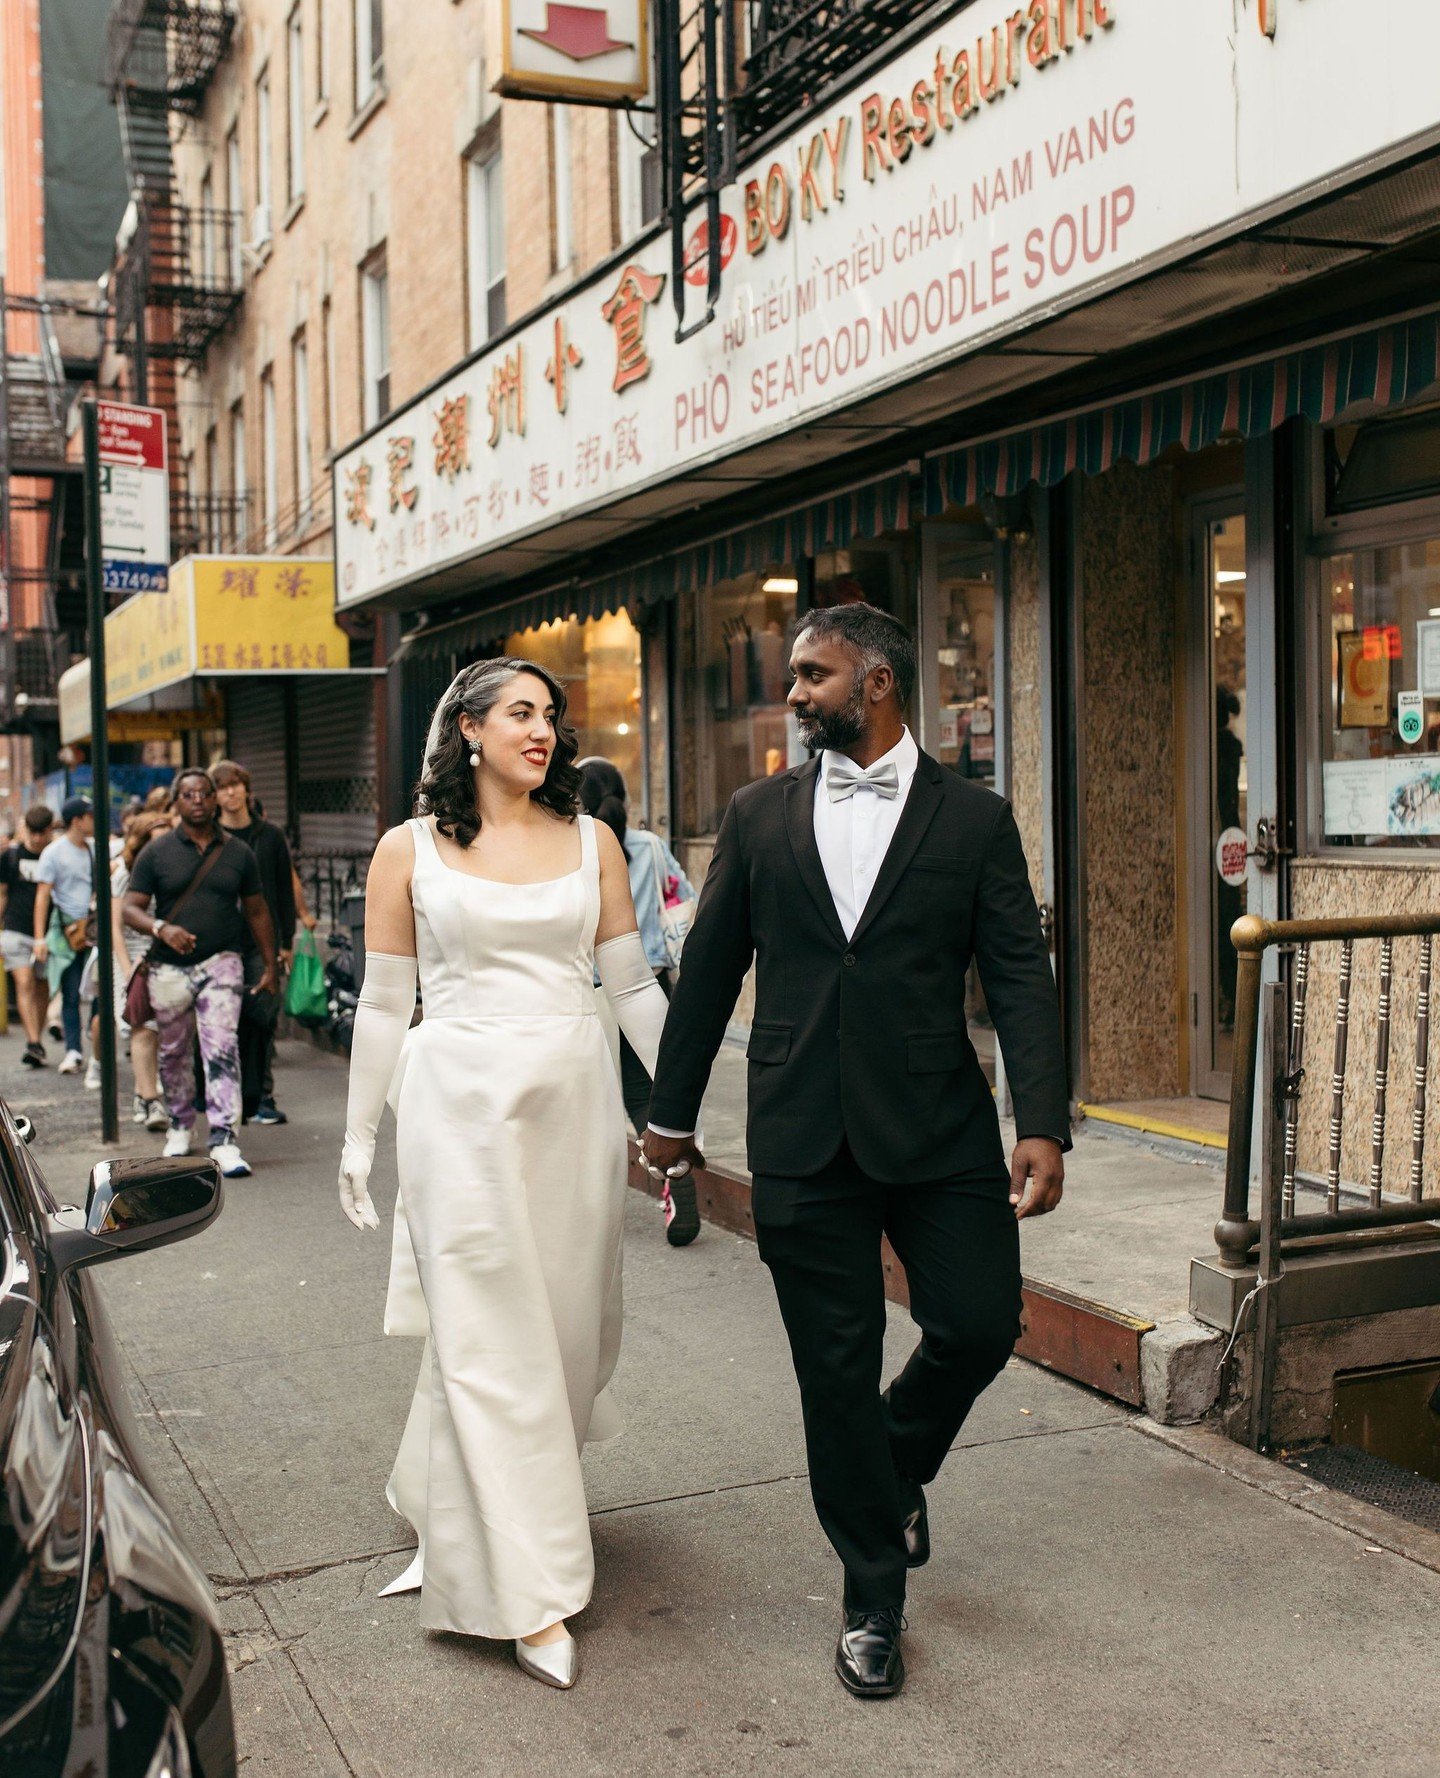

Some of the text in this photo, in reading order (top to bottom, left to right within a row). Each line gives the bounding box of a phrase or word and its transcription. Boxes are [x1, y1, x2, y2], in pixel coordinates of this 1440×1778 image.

[744, 163, 790, 256] BO
[798, 116, 850, 221] KY
[892, 184, 964, 263] CHÂU,
[972, 150, 1033, 221] NAM
[1043, 97, 1136, 178] VANG
[750, 315, 870, 415] SEAFOOD
[881, 243, 1011, 358] NOODLE
[1023, 185, 1135, 289] SOUP
